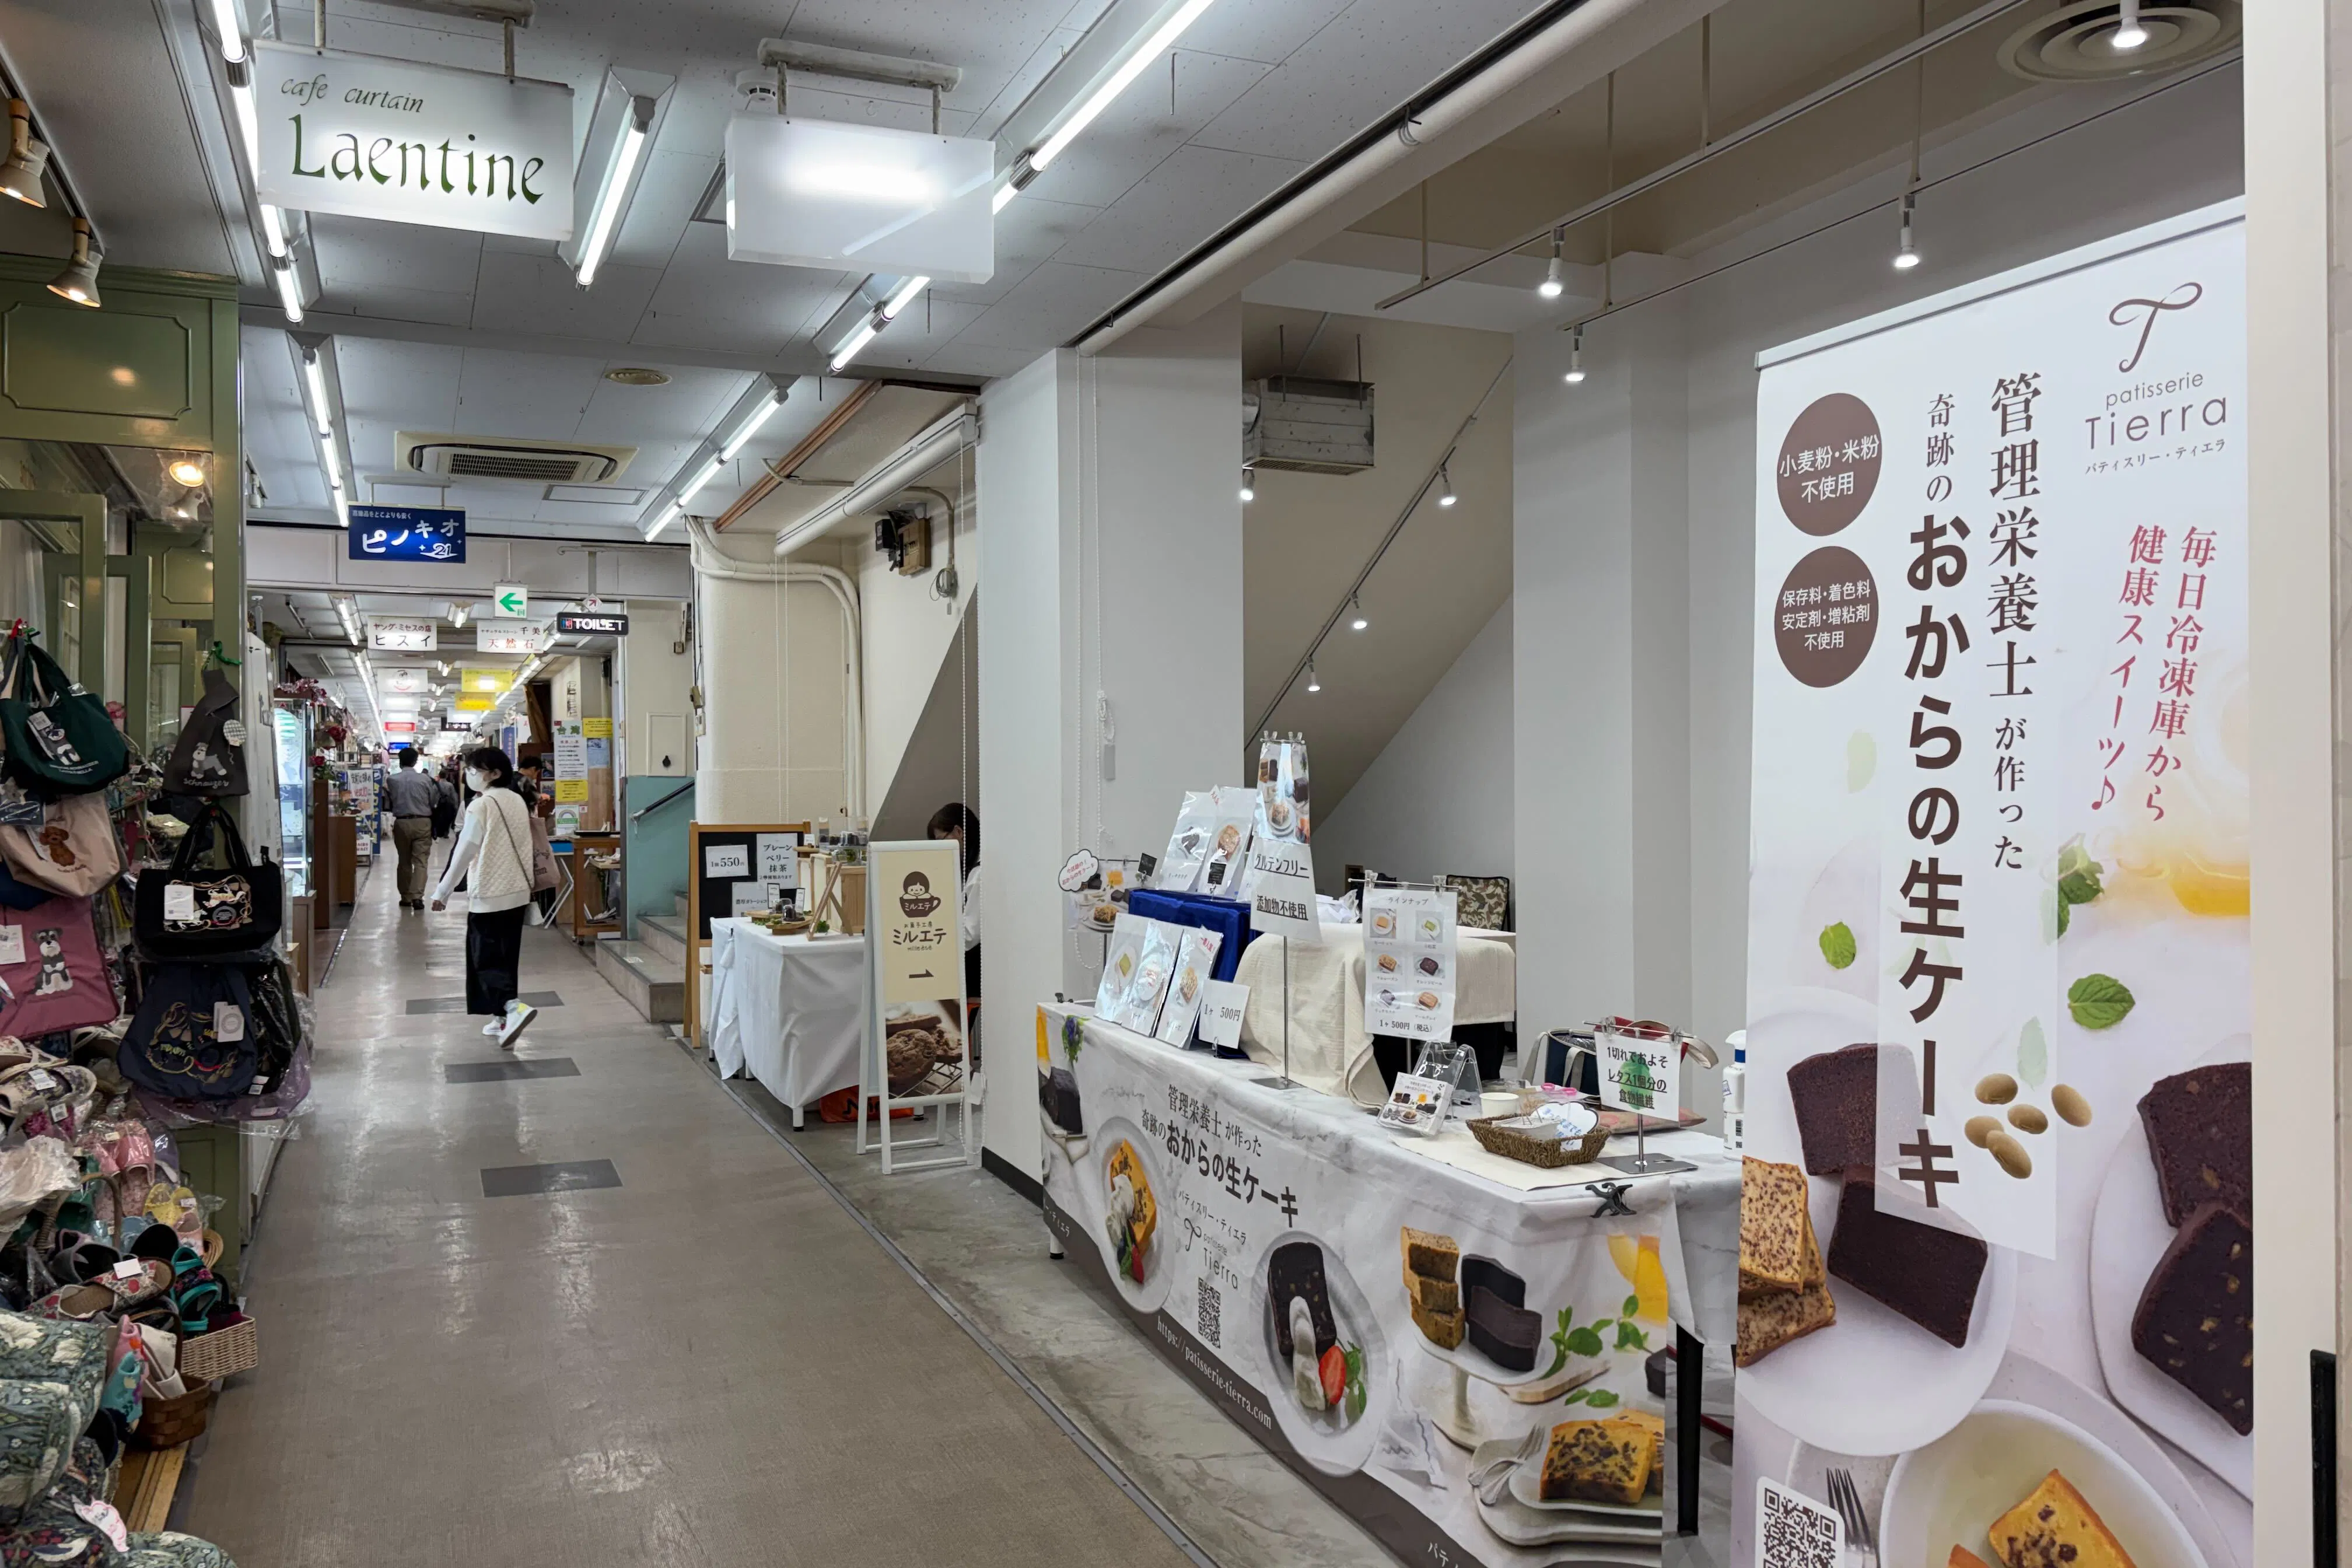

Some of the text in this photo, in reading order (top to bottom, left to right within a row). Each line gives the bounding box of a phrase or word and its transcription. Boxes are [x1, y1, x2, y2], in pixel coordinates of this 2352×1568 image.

[281, 74, 424, 113] cafe curtain
[288, 114, 545, 205] Laentine
[2106, 372, 2204, 411] patisserie
[2085, 397, 2227, 449] Tierra
[1779, 433, 1880, 478] 小麦粉・米粉
[2085, 439, 2226, 474] パティスリー・ティエラ
[1801, 471, 1854, 503] 不使用
[362, 519, 459, 554] ピノキオ
[1782, 579, 1871, 608] 保存料・着色料
[373, 623, 432, 633] ヤング・ミセスの店
[572, 618, 625, 631] TOILET
[1782, 603, 1870, 631] 安定剤・増粘剤
[1986, 371, 2042, 870] 管理栄養士が作った
[375, 634, 431, 647] ヒスイ
[488, 638, 535, 649] 天然石
[1804, 630, 1845, 652] 不使用
[2146, 526, 2217, 822] 毎日冷凍庫から
[1898, 393, 1971, 1209] 奇跡のおからの生ケーキ
[769, 864, 788, 873] 抹茶
[1255, 853, 1308, 876] グルテンフリー
[904, 902, 931, 911] ミルエテ
[1256, 894, 1307, 920] 添加物不使用
[1387, 897, 1429, 905] ラインナップ
[892, 928, 947, 946] ミルエテ
[1220, 1007, 1241, 1021] 500円
[1391, 1020, 1410, 1030] 500円
[1607, 1046, 1668, 1069] 1切れでおよそ
[1608, 1068, 1667, 1091] レタス1個分の
[1168, 1084, 1262, 1157] 管理栄養士が作った
[1142, 1108, 1298, 1228] 奇跡のおからの生ケーキ
[1203, 1247, 1238, 1290] Tierra
[1427, 1542, 1458, 1568] パテ
